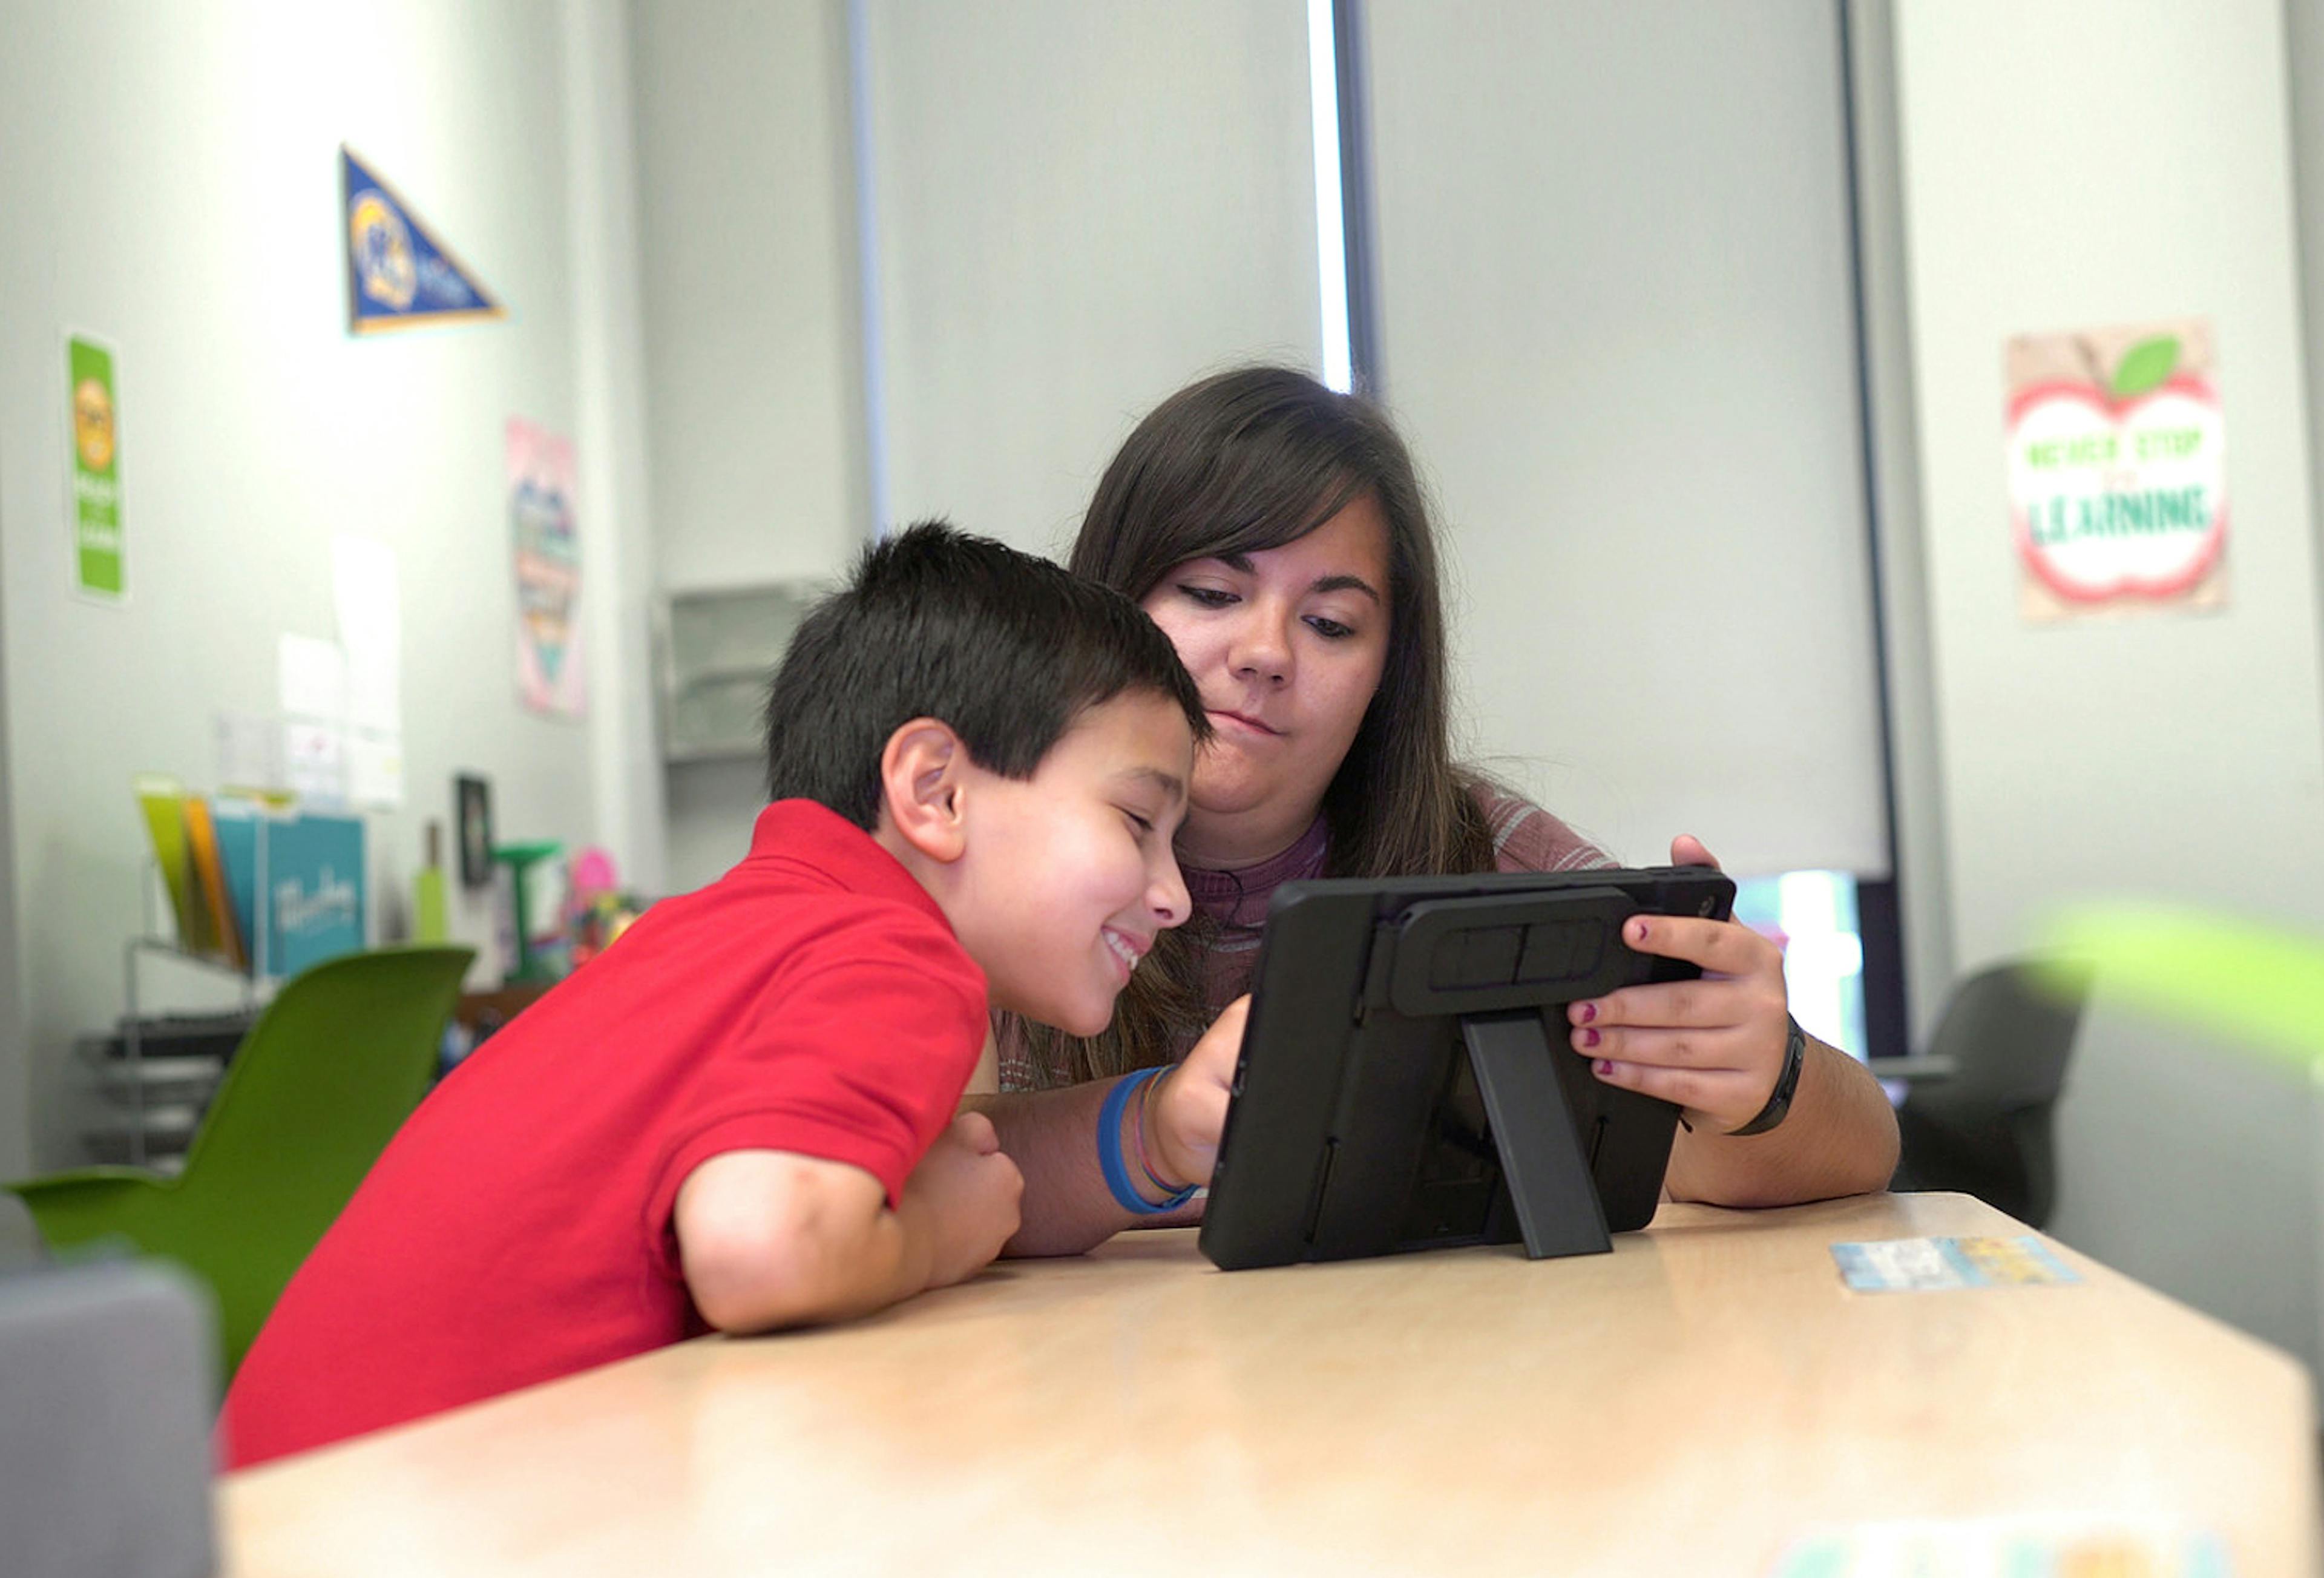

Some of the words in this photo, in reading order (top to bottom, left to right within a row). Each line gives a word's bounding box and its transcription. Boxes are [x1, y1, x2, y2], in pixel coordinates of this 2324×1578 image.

[2027, 436, 2118, 467] NEVER
[2135, 426, 2202, 459] STOP
[2029, 486, 2210, 544] LEARNING
